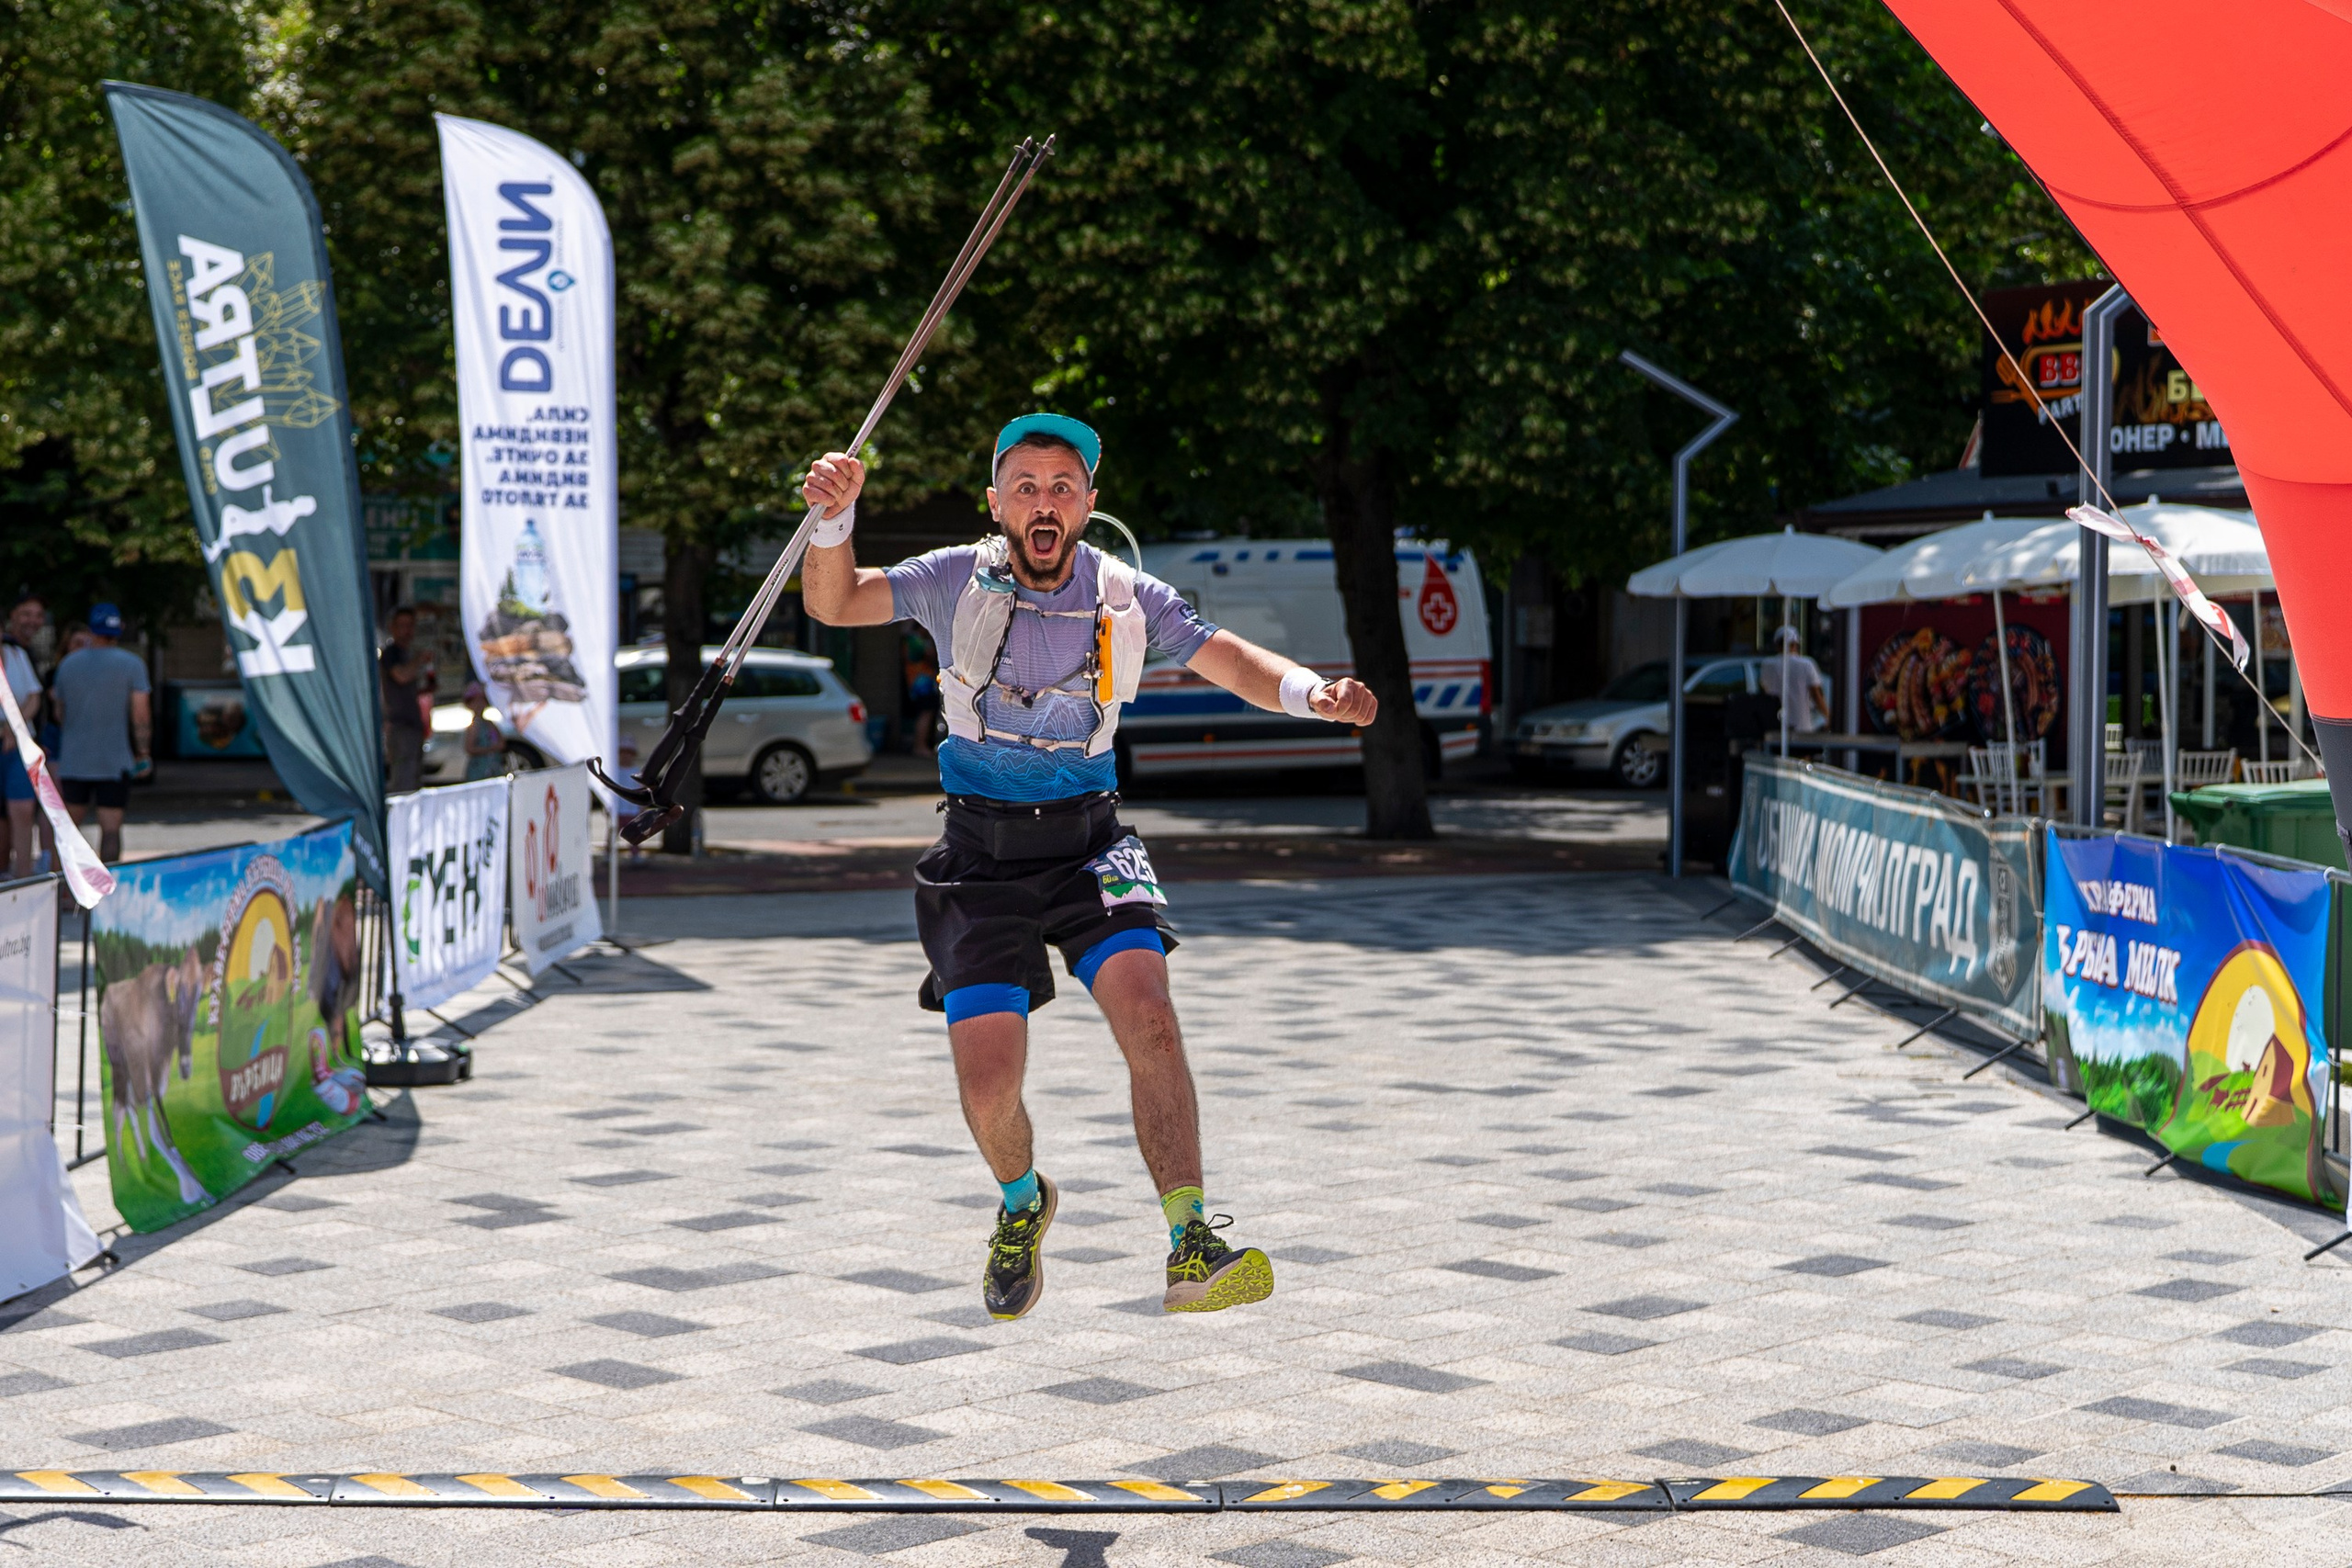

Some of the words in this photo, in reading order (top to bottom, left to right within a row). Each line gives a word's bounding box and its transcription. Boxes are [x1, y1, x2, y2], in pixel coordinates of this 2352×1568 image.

[2040, 353, 2083, 388] BB
[2037, 391, 2083, 425] PART
[1106, 847, 1158, 885] 625
[2123, 939, 2181, 1006] МИЛК
